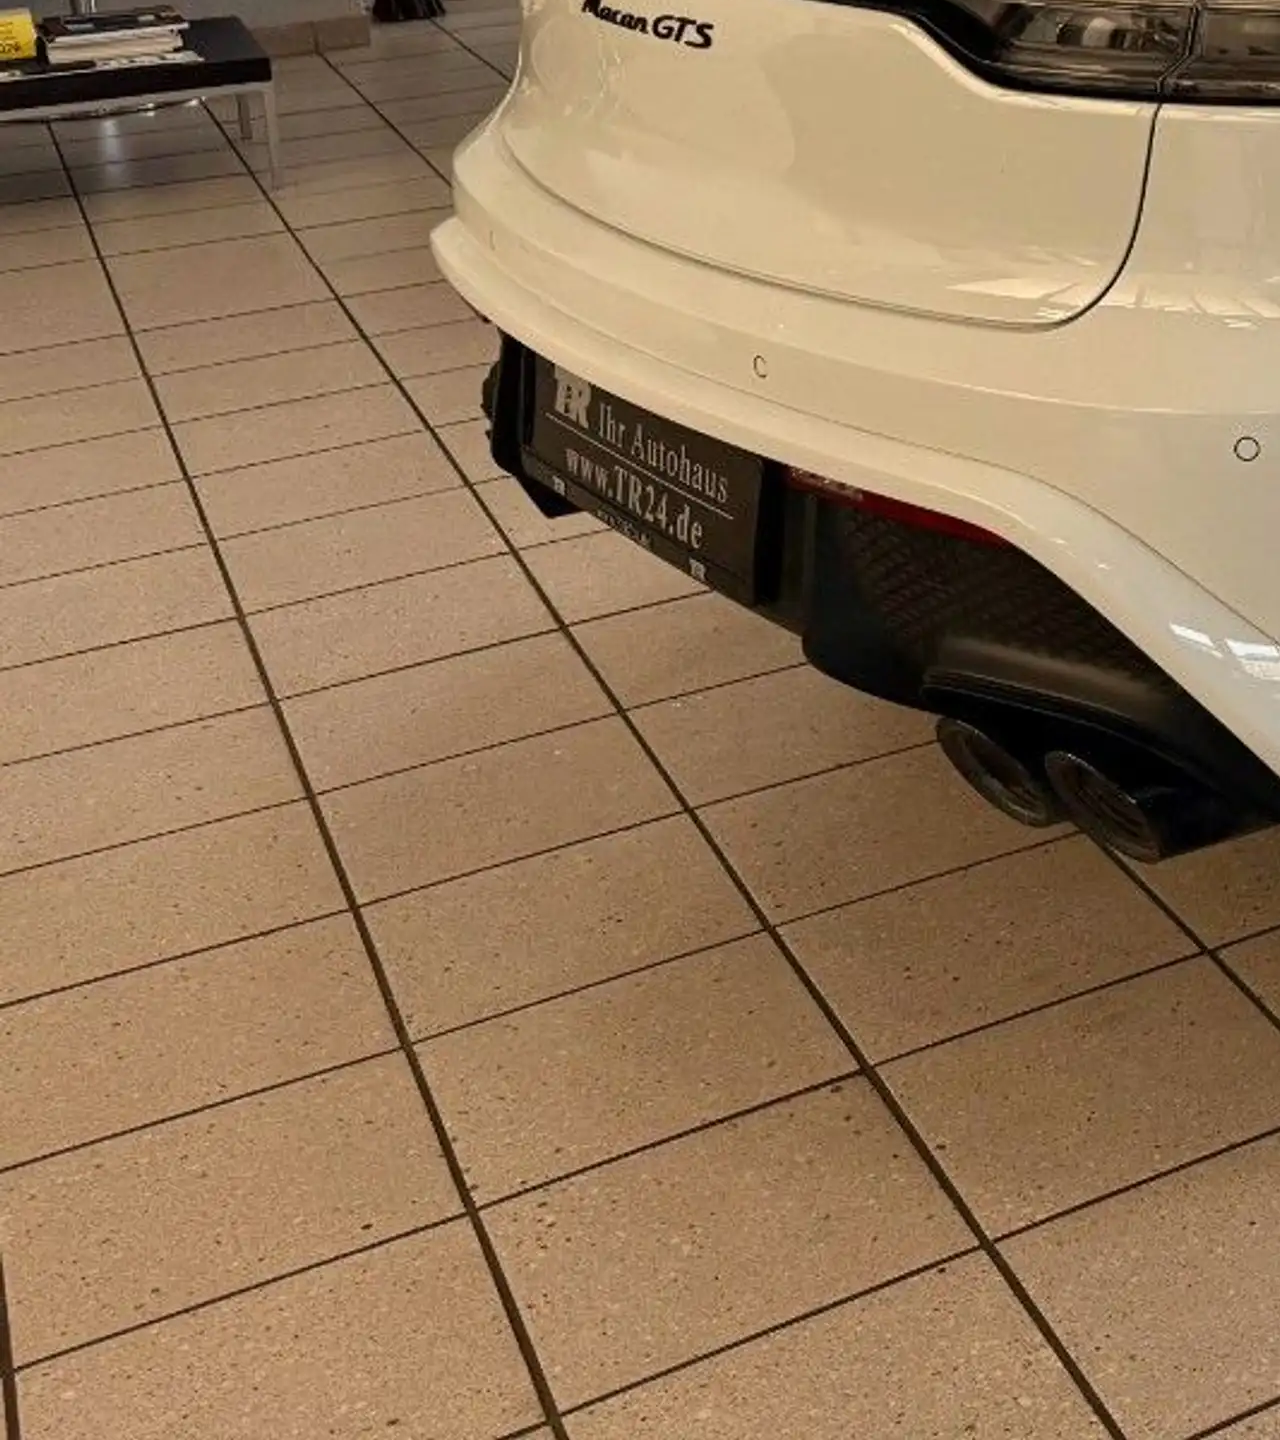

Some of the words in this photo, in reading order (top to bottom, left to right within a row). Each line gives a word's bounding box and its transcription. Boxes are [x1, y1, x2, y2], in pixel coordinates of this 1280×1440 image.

[652, 14, 714, 49] GTS
[566, 448, 703, 549] www.TR24.de
[599, 403, 625, 448] Ihr
[631, 424, 729, 504] Autohaus
